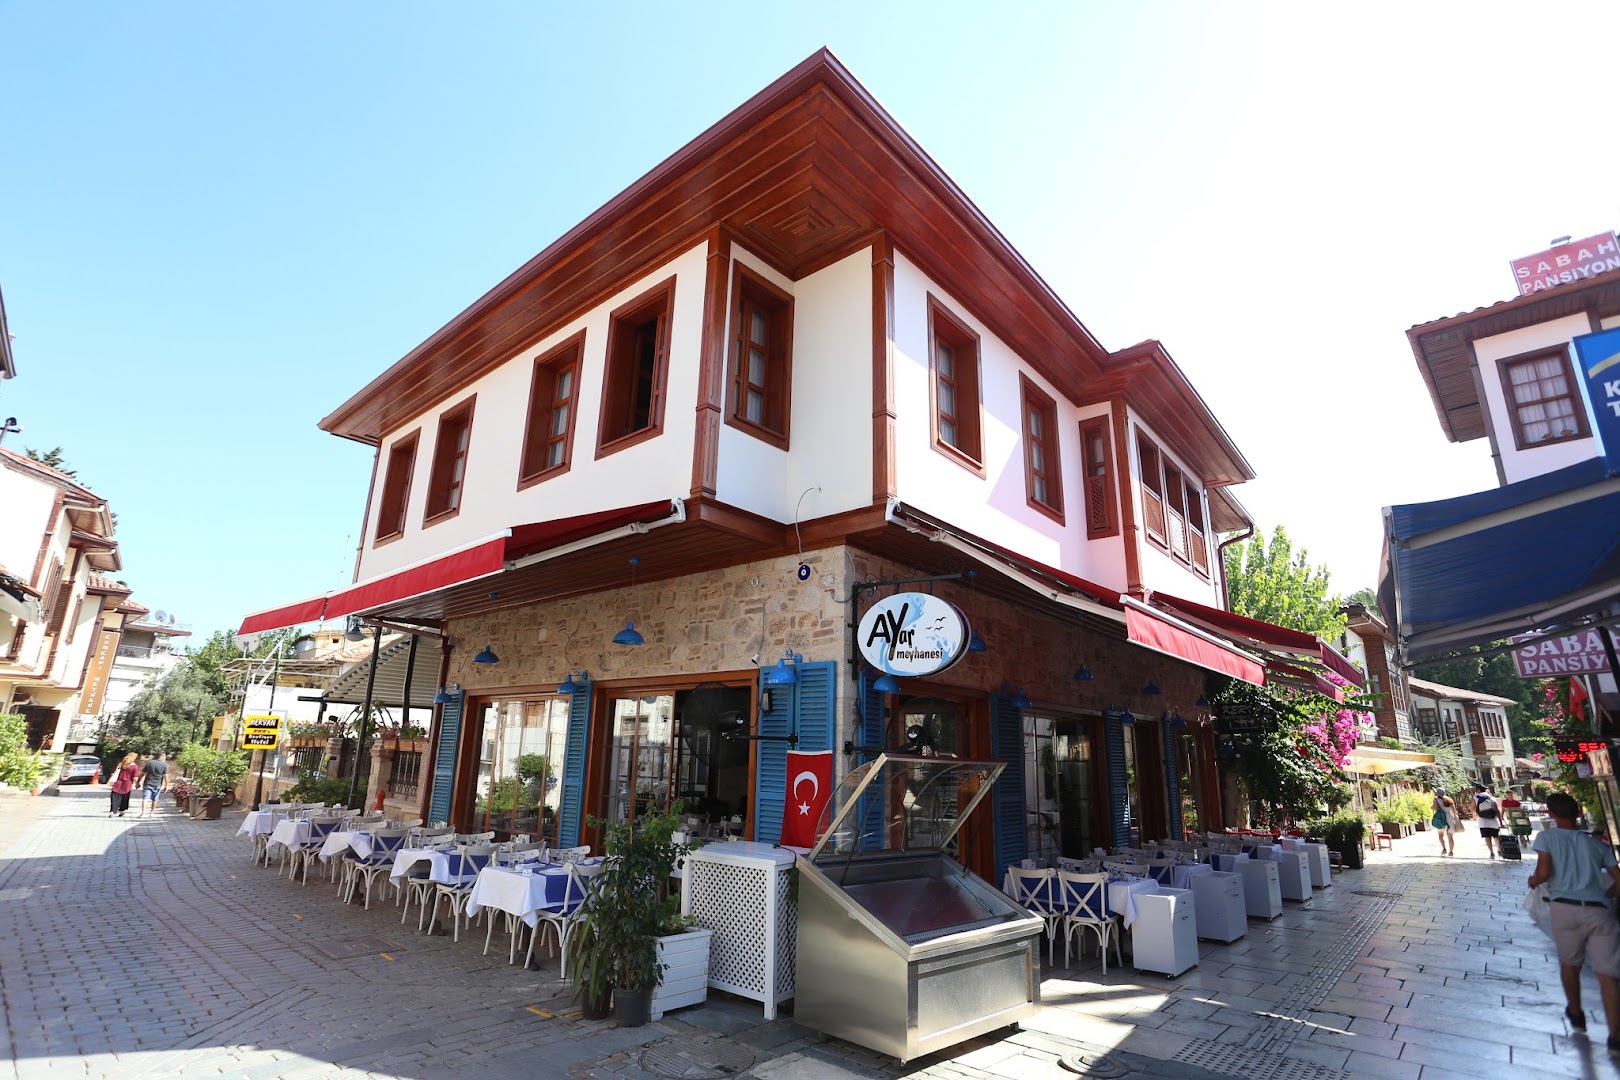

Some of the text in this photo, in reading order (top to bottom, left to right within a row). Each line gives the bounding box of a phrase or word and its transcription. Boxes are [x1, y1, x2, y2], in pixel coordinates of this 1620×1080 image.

[1517, 240, 1615, 278] SABAH
[896, 647, 943, 663] meyhanesi
[1523, 652, 1620, 674] PANSİY
[85, 676, 100, 714] MEYHANE
[250, 718, 276, 726] KERVAN
